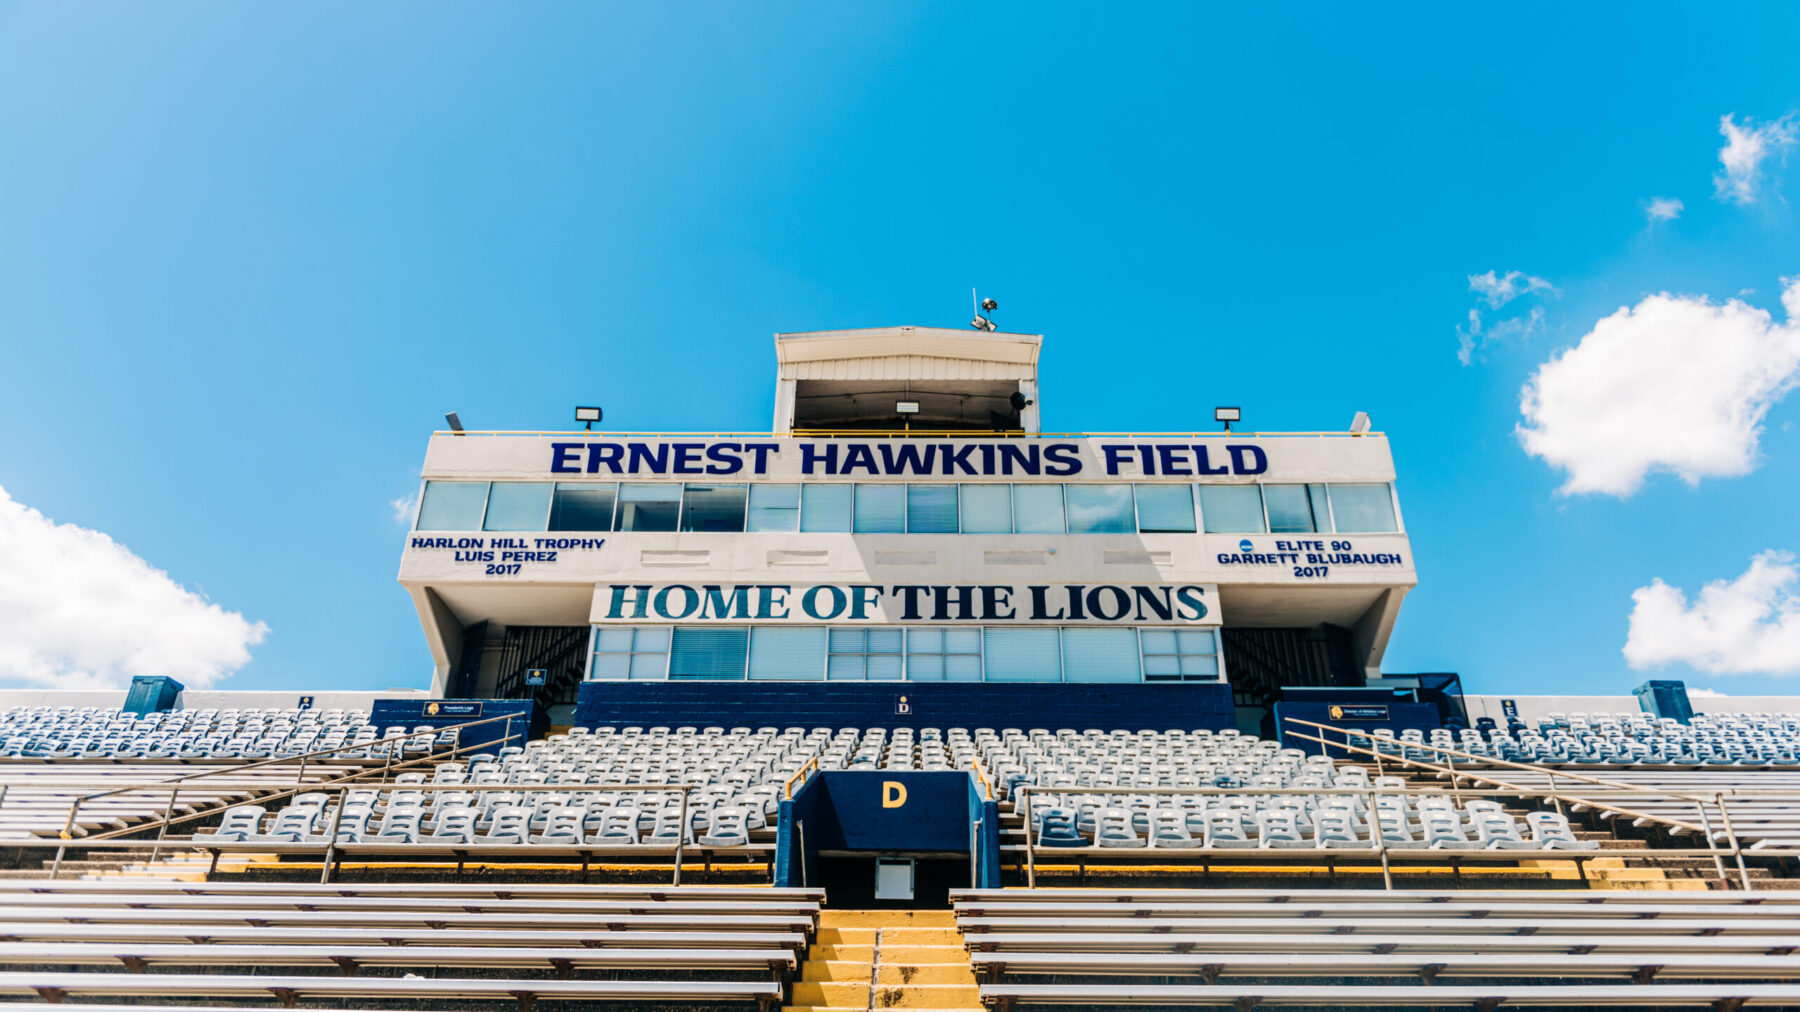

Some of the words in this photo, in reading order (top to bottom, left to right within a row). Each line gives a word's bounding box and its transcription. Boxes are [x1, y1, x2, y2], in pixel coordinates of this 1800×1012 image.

[551, 442, 779, 475] ERNEST
[799, 443, 1082, 476] HAWKINS
[1101, 444, 1268, 476] FIELD
[411, 537, 484, 549] HARLON
[490, 538, 528, 549] HILL
[534, 538, 606, 549] TROPHY
[1275, 540, 1324, 551] ELITE
[1331, 540, 1352, 551] 90
[454, 550, 495, 562] LUIS
[501, 551, 558, 562] PEREZ
[1217, 553, 1299, 565] GARRETT
[1306, 553, 1402, 565] BLUBAUGH
[485, 563, 522, 575] 2017
[1293, 566, 1329, 578] 2017
[605, 584, 791, 620] HOME
[801, 584, 884, 620] OF
[891, 584, 1016, 620] THE
[1027, 585, 1208, 621] LIONS
[898, 703, 909, 713] D
[1504, 706, 1515, 716] E
[882, 781, 908, 809] D
